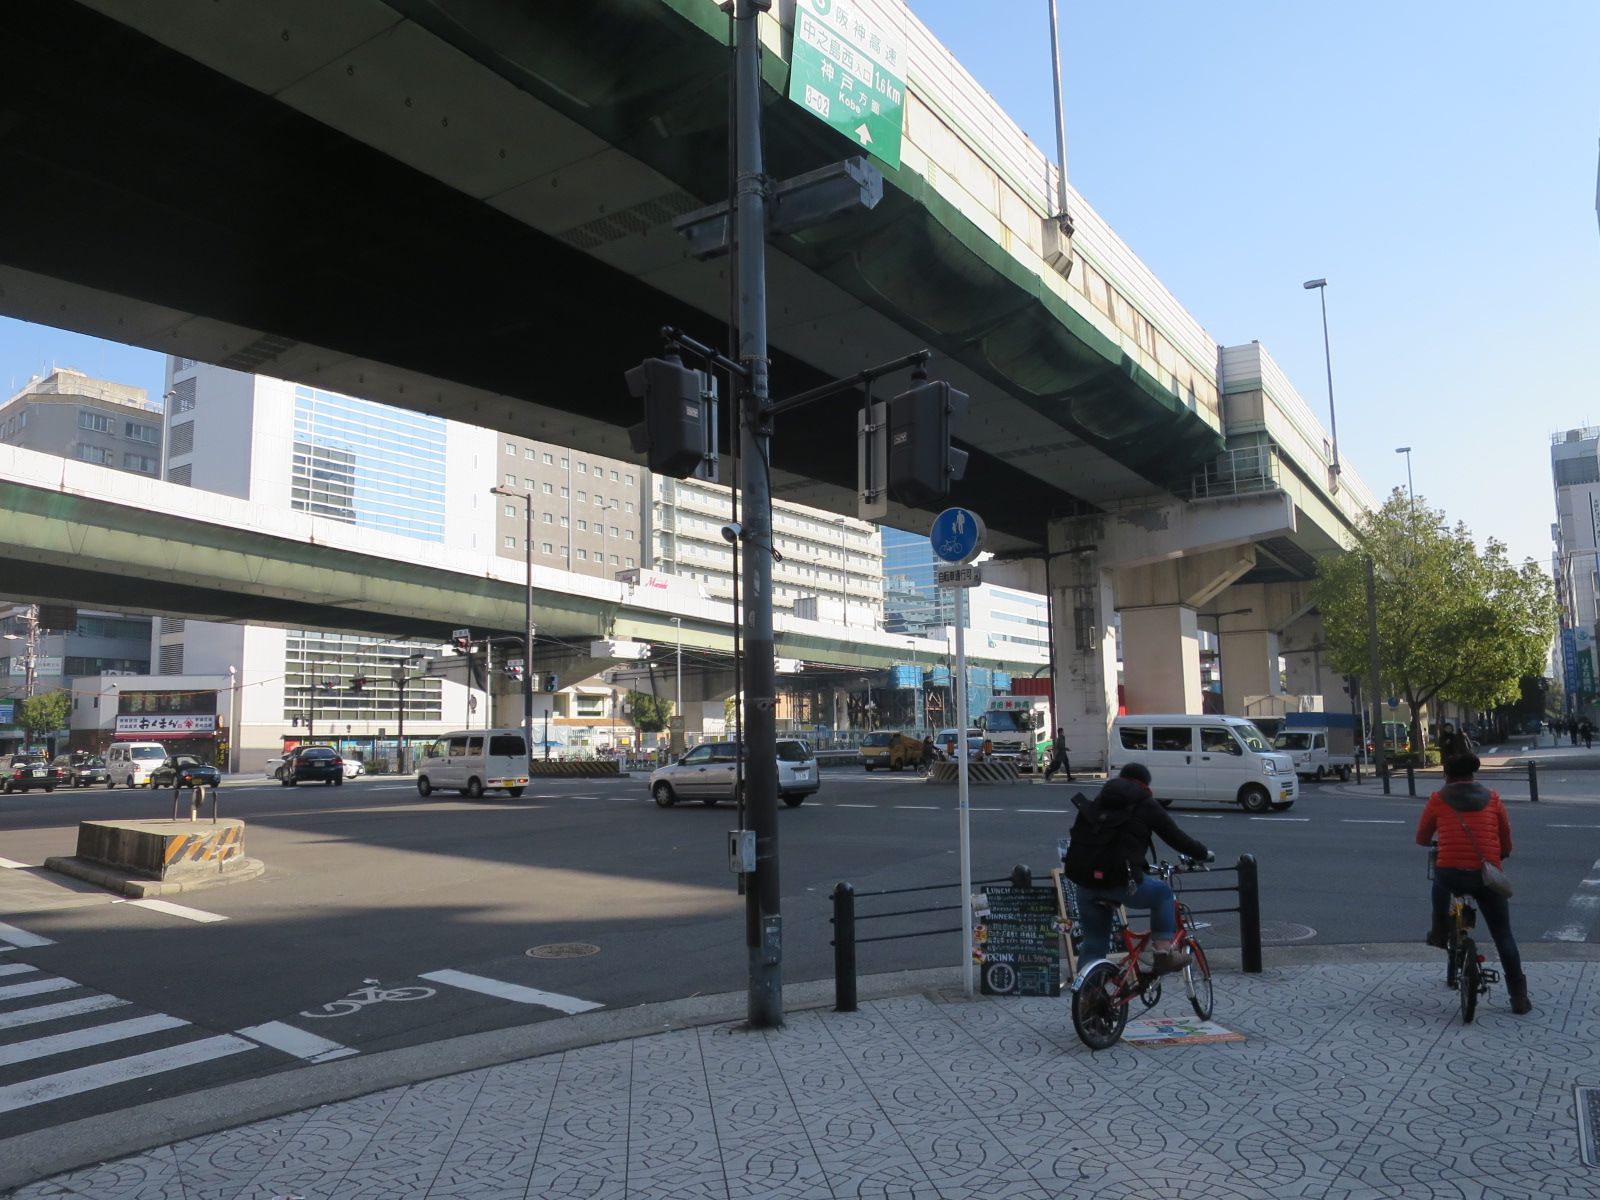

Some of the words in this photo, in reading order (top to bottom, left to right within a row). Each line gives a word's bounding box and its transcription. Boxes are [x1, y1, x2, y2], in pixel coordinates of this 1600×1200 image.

[835, 6, 897, 67] 阪神高速
[807, 87, 828, 115] 3-02
[838, 91, 861, 114] Kobe
[986, 887, 1011, 895] LUNCH
[986, 953, 1015, 962] DRINK
